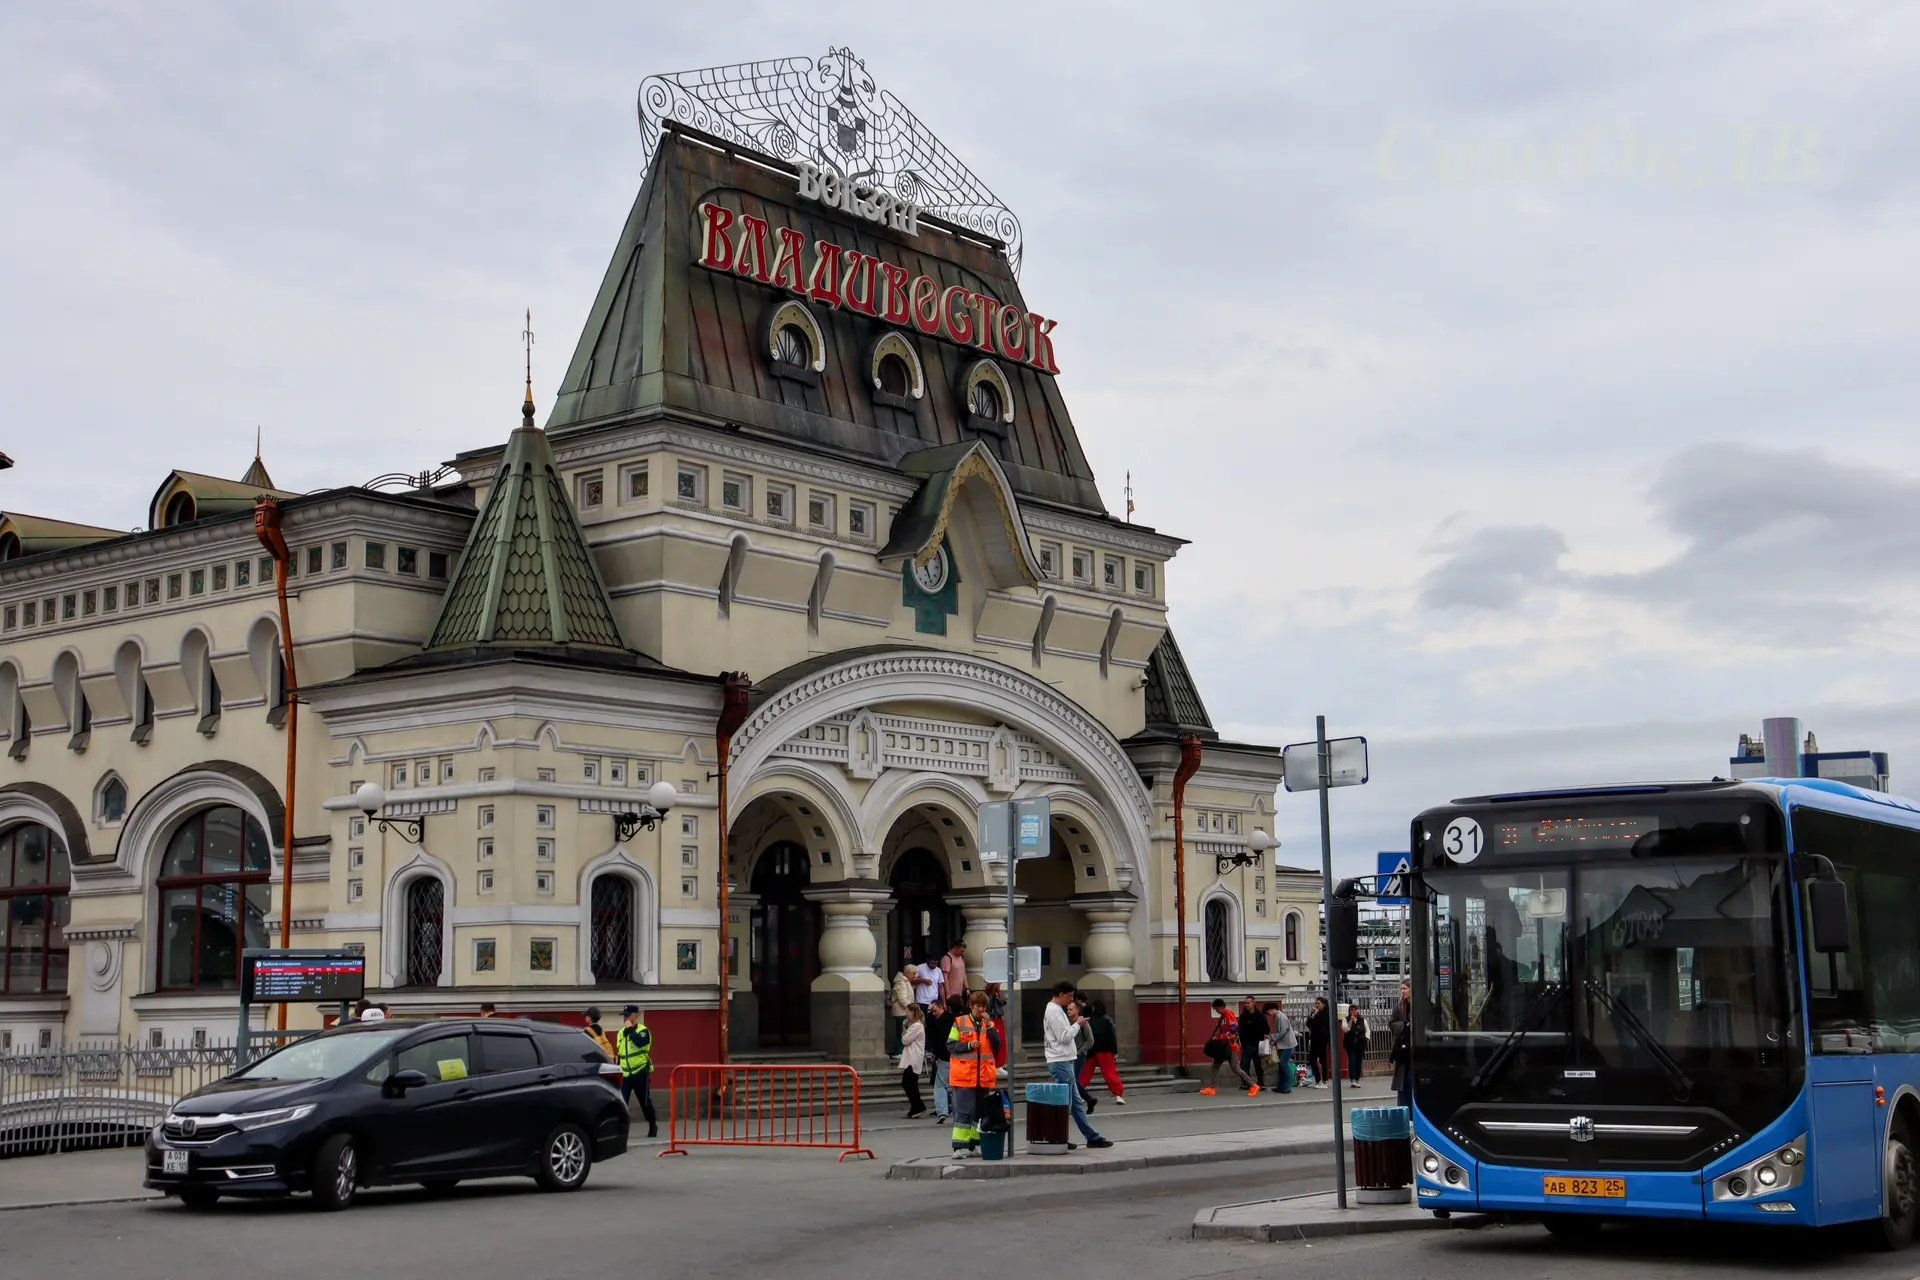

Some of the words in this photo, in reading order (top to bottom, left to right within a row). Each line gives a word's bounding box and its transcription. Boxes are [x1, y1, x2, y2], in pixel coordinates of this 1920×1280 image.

[794, 161, 922, 237] ВОКЗАЛ
[699, 202, 1060, 375] ВЛАДИВОСТОК
[1447, 824, 1478, 856] 31
[1550, 1182, 1566, 1193] АВ
[1572, 1180, 1598, 1194] 823
[1605, 1180, 1620, 1192] 25
